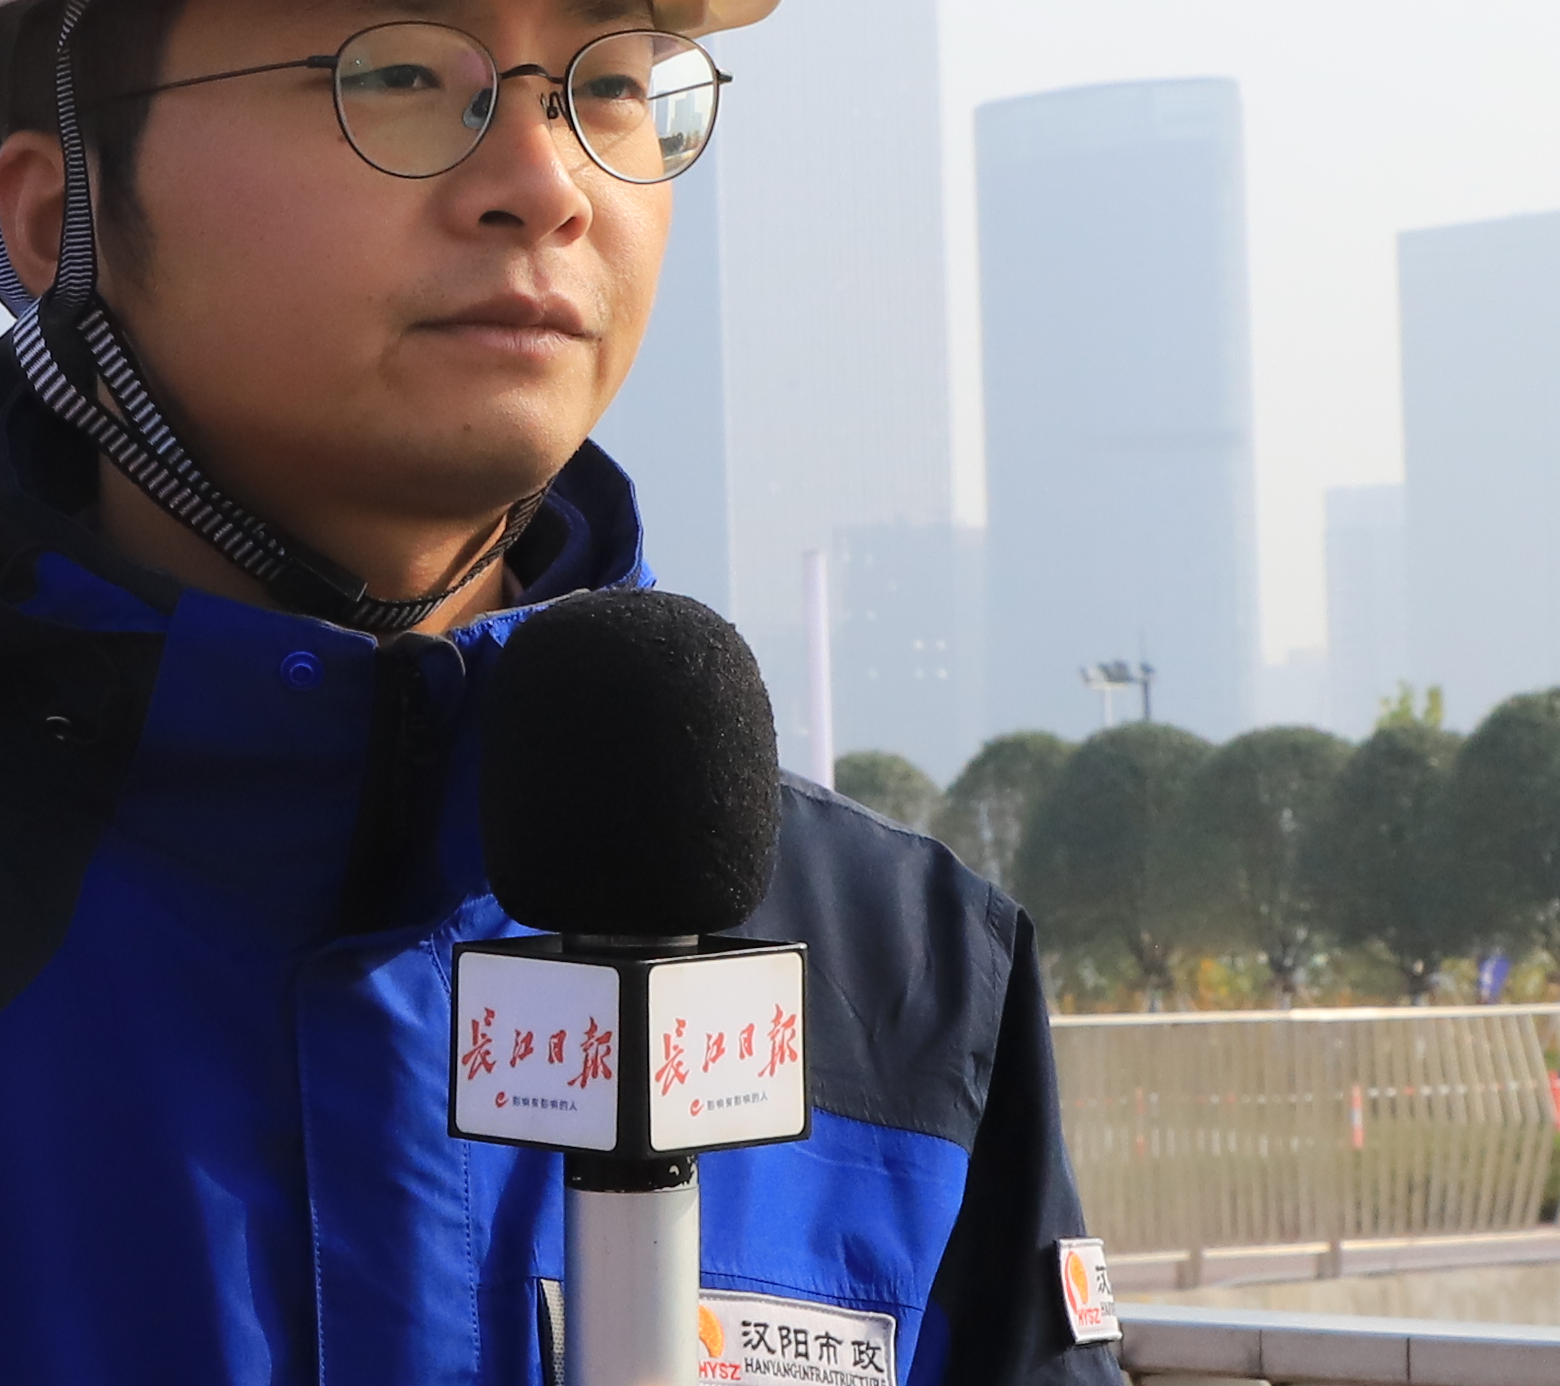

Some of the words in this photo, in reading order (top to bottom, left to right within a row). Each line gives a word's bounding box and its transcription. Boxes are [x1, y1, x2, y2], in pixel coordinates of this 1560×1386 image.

[740, 1319, 885, 1374] 汉阳市政
[698, 1360, 742, 1381] HYSZ
